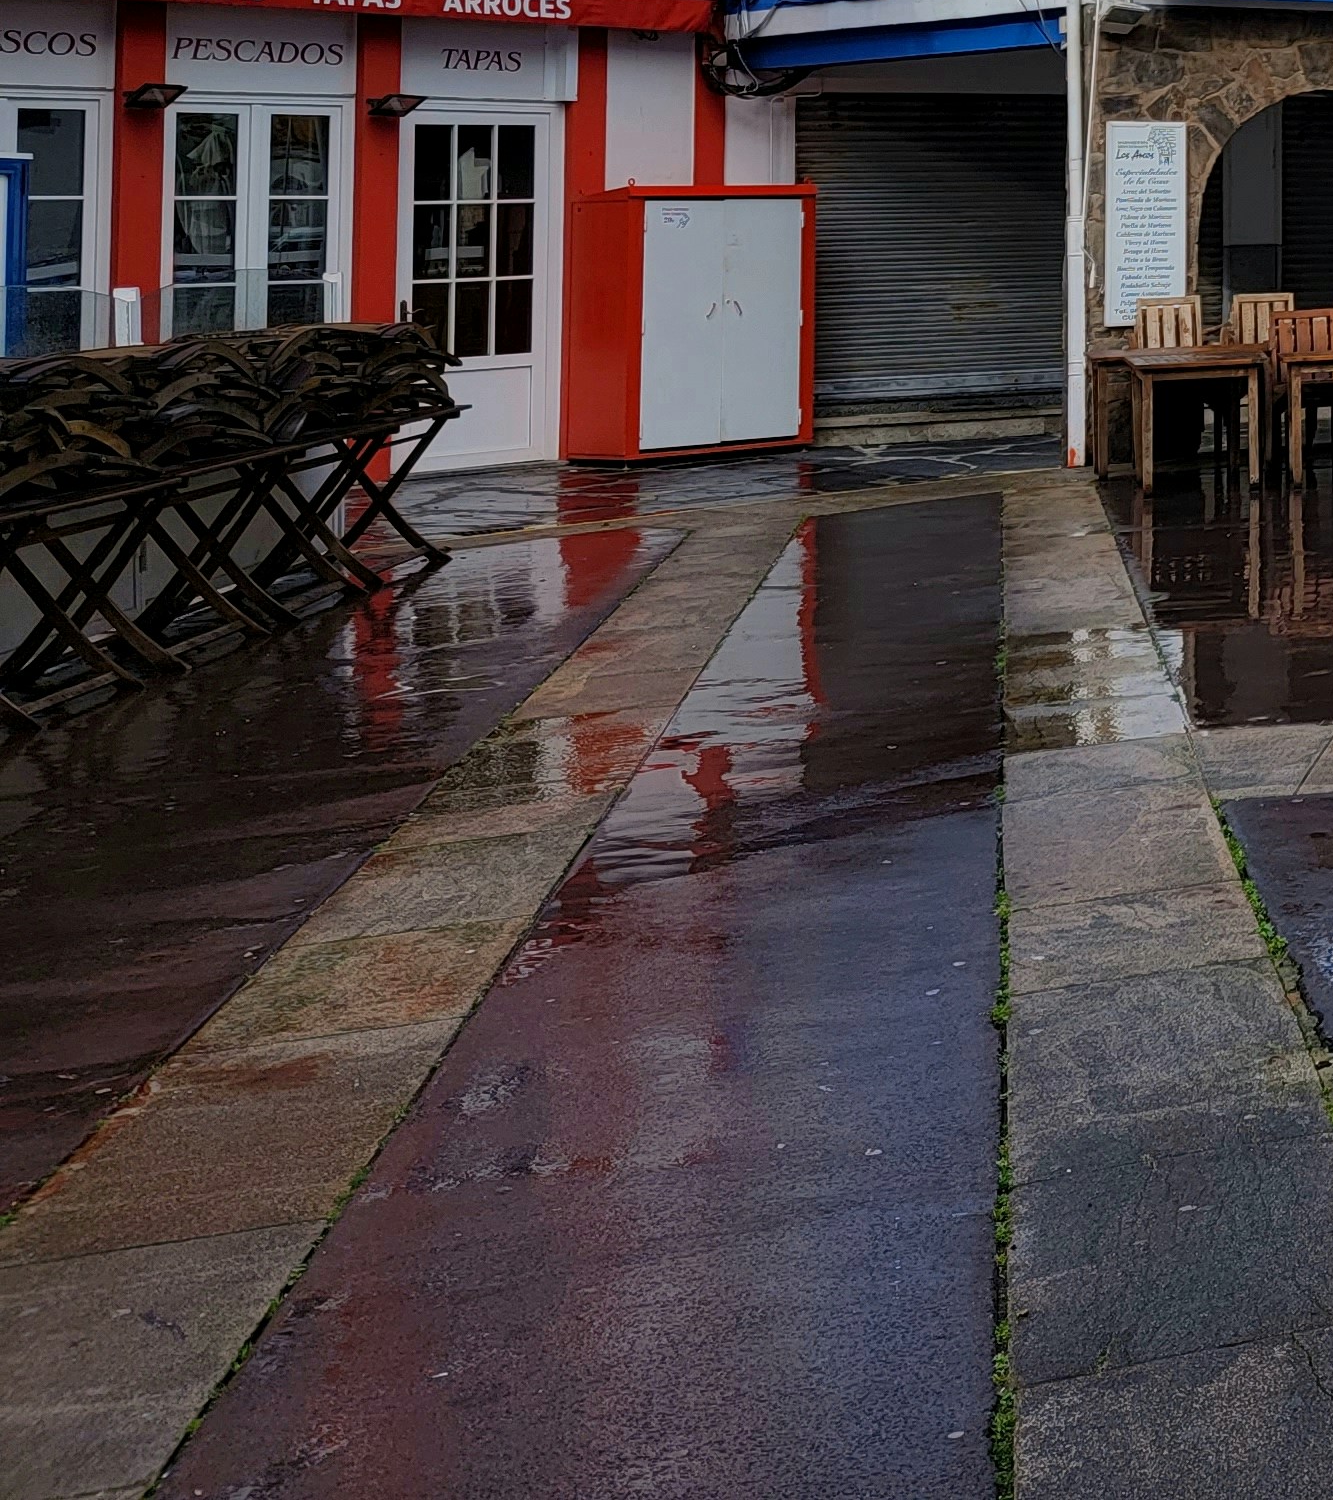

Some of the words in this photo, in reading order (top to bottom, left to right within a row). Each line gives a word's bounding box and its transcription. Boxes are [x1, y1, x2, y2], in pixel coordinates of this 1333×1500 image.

[0, 29, 97, 57] SCOS
[171, 36, 345, 66] PESCADOS
[441, 47, 523, 73] TAPAS
